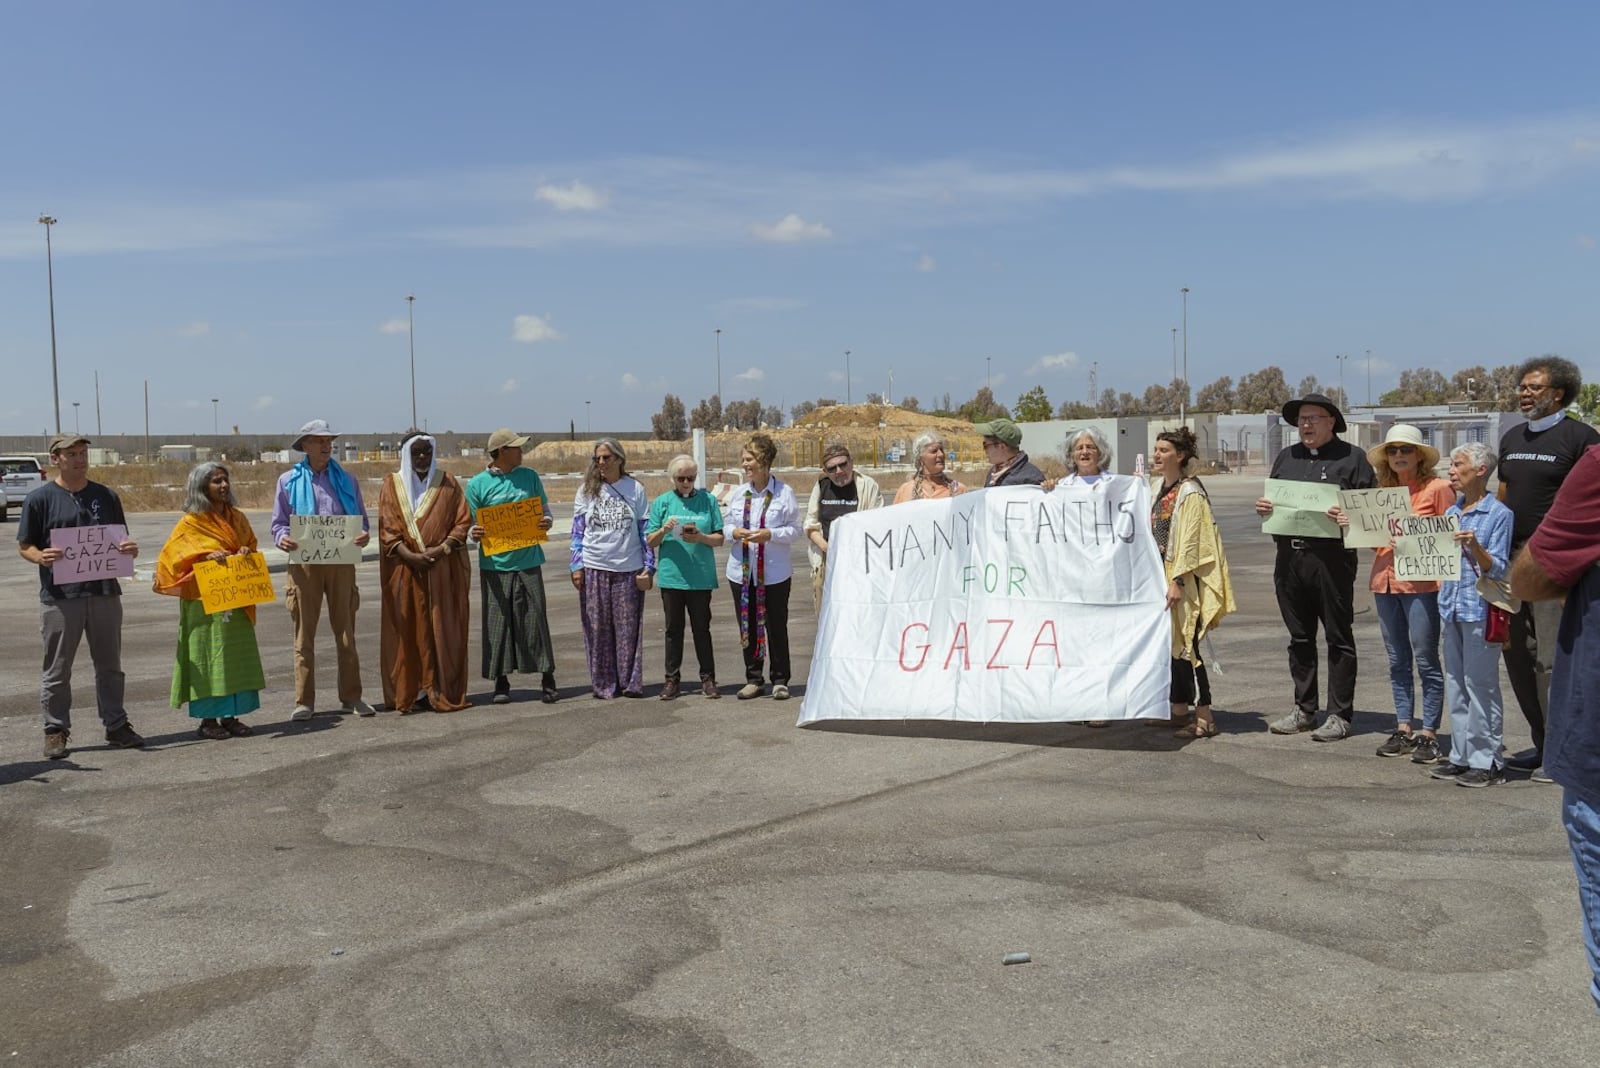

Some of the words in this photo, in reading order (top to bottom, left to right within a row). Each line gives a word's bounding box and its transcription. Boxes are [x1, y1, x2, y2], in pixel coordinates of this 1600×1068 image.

[1537, 454, 1557, 462] NOW
[1341, 491, 1370, 510] LET
[1375, 490, 1408, 512] GAZA
[481, 499, 542, 524] BURMESE
[77, 527, 107, 545] LET
[311, 529, 345, 540] VOICES
[1402, 516, 1455, 536] CHRISTIANS
[320, 540, 326, 549] 4
[864, 505, 975, 574] MANY
[1004, 500, 1136, 546] FAITHS
[1418, 535, 1440, 556] FOR
[64, 542, 121, 561] GAZA
[301, 547, 341, 562] GAZA
[76, 558, 118, 574] LIVE
[1397, 555, 1457, 577] CEASEFIRE
[208, 576, 231, 589] SAYS
[962, 562, 1028, 598] FOR
[210, 585, 239, 607] STOP
[247, 583, 274, 600] BOMBS
[898, 618, 1063, 673] GAZA
